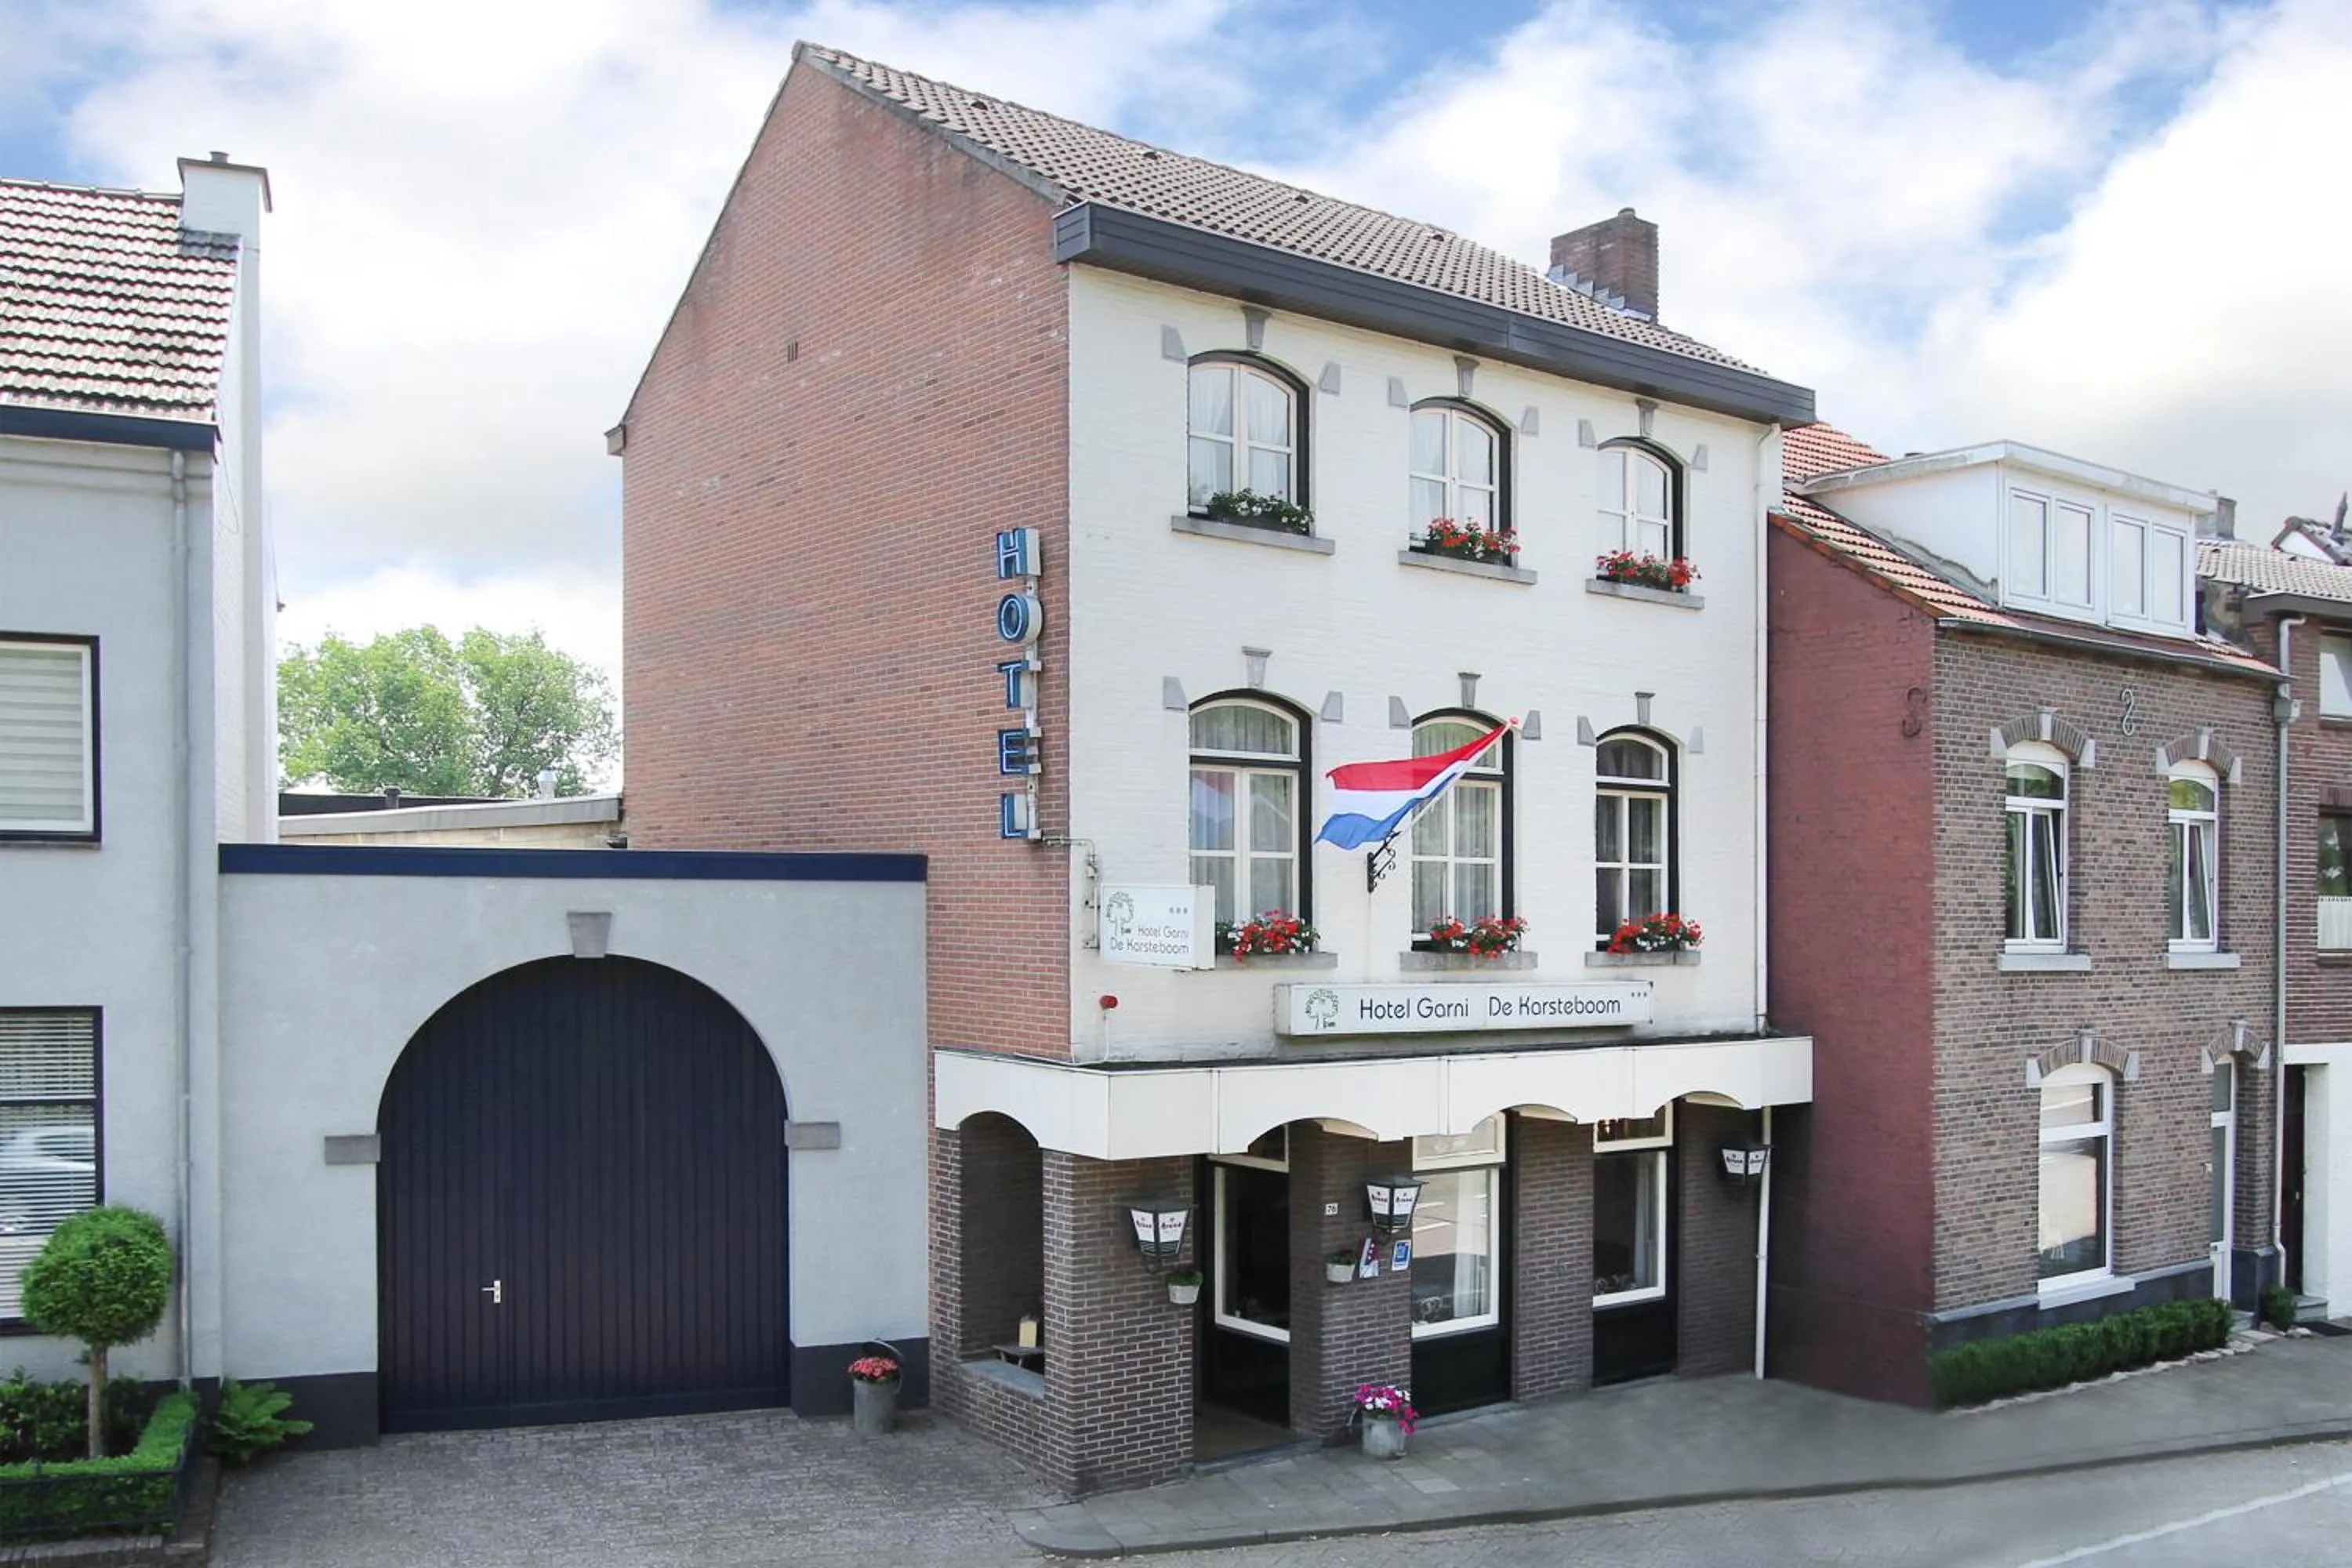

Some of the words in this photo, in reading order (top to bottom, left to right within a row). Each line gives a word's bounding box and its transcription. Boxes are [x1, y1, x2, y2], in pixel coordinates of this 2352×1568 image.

[996, 527, 1041, 840] HOTEL
[1138, 925, 1161, 938] Hotel
[1111, 937, 1123, 951] De
[1360, 998, 1410, 1019] Hotel
[1417, 997, 1468, 1018] Garni
[1489, 996, 1512, 1017] De
